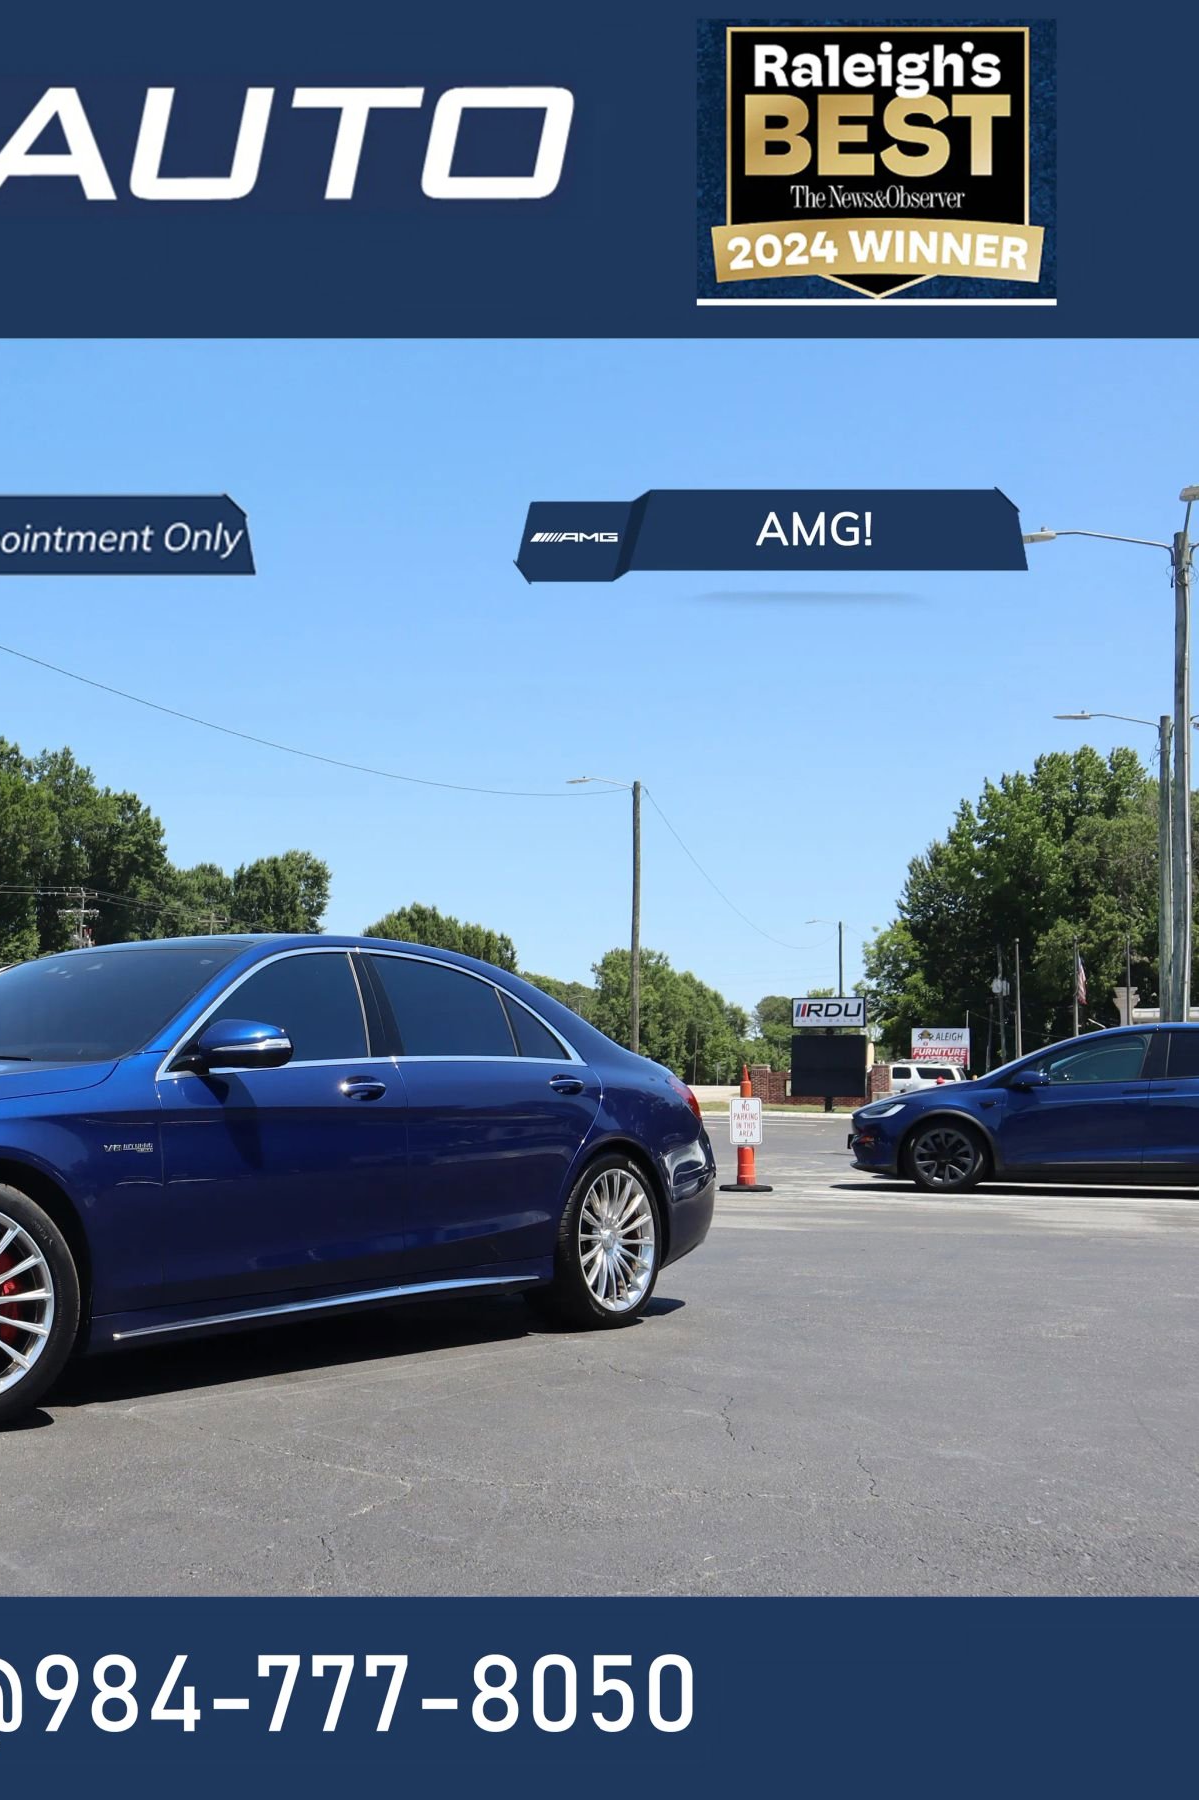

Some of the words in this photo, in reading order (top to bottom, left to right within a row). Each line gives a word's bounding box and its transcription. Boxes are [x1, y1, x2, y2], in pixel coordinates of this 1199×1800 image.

[806, 1003, 862, 1017] RDU
[913, 1047, 967, 1056] FURNITURE
[741, 1103, 750, 1111] NO
[733, 1112, 759, 1121] PARKING
[736, 1121, 742, 1129] IN
[744, 1121, 757, 1129] THIS
[738, 1130, 754, 1138] AREA
